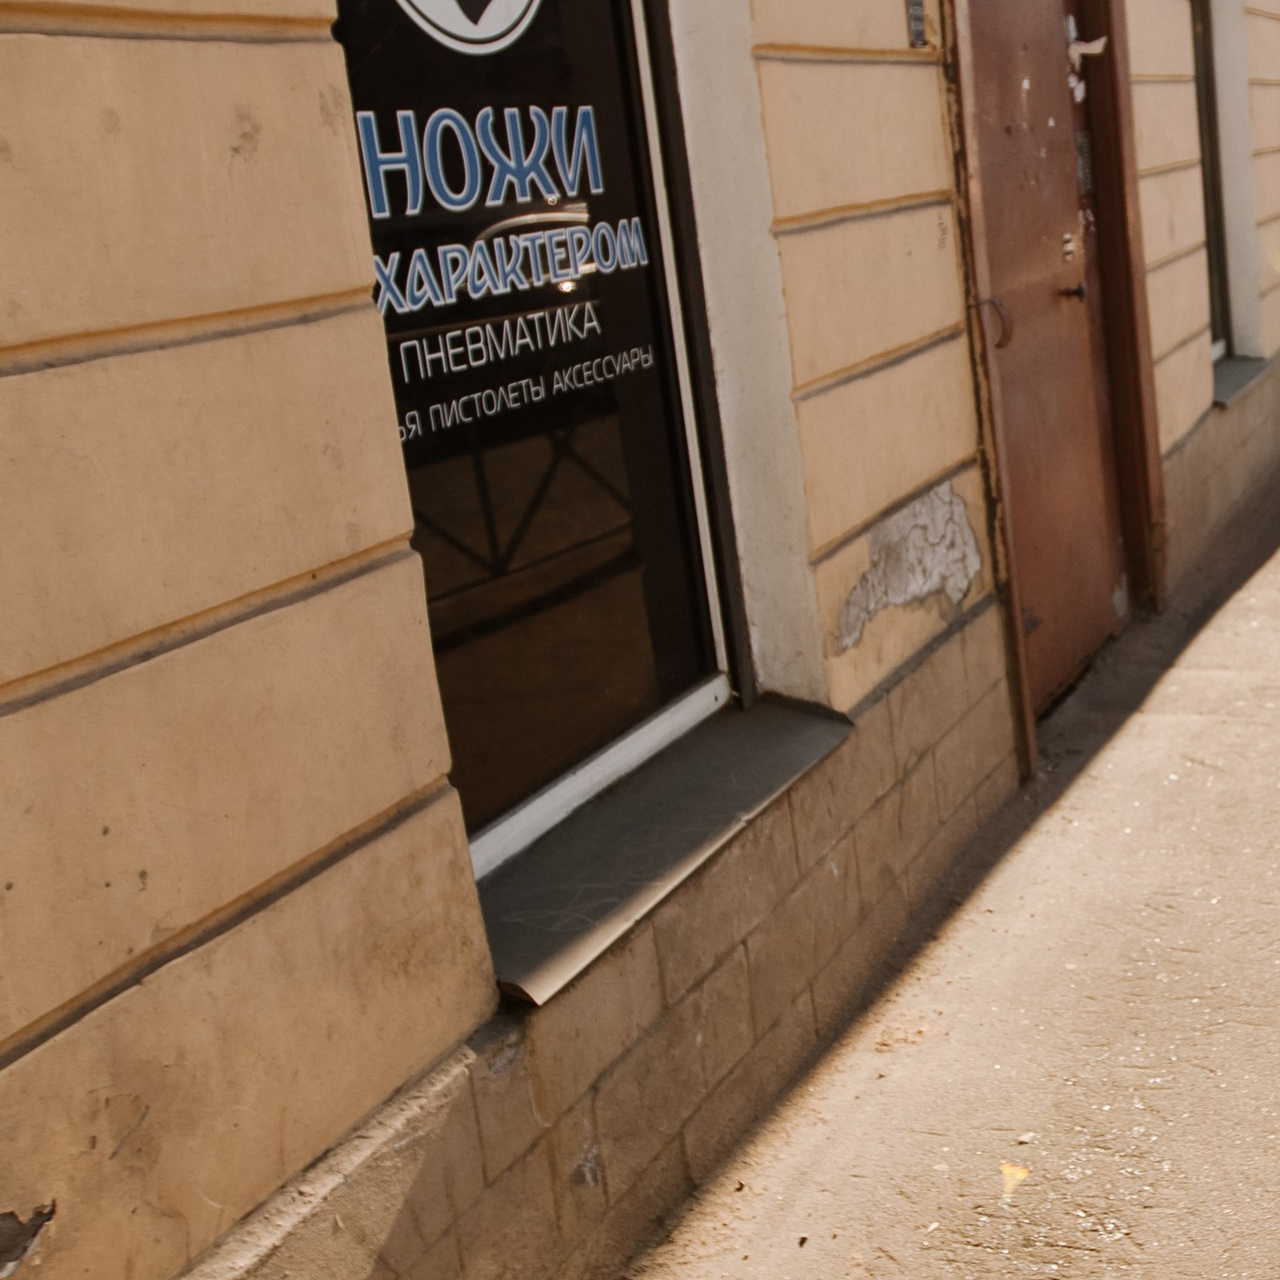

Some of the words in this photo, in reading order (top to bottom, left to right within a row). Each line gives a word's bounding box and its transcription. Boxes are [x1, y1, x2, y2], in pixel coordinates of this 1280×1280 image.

[356, 105, 604, 219] НОЖИ
[373, 216, 649, 317] ХАРАКТЕРОМ
[400, 301, 602, 384] ПНЕВМАТИКА
[429, 374, 545, 432] ПИСТОЛЕТЫ
[551, 344, 654, 396] АКСЕССУАРЫ
